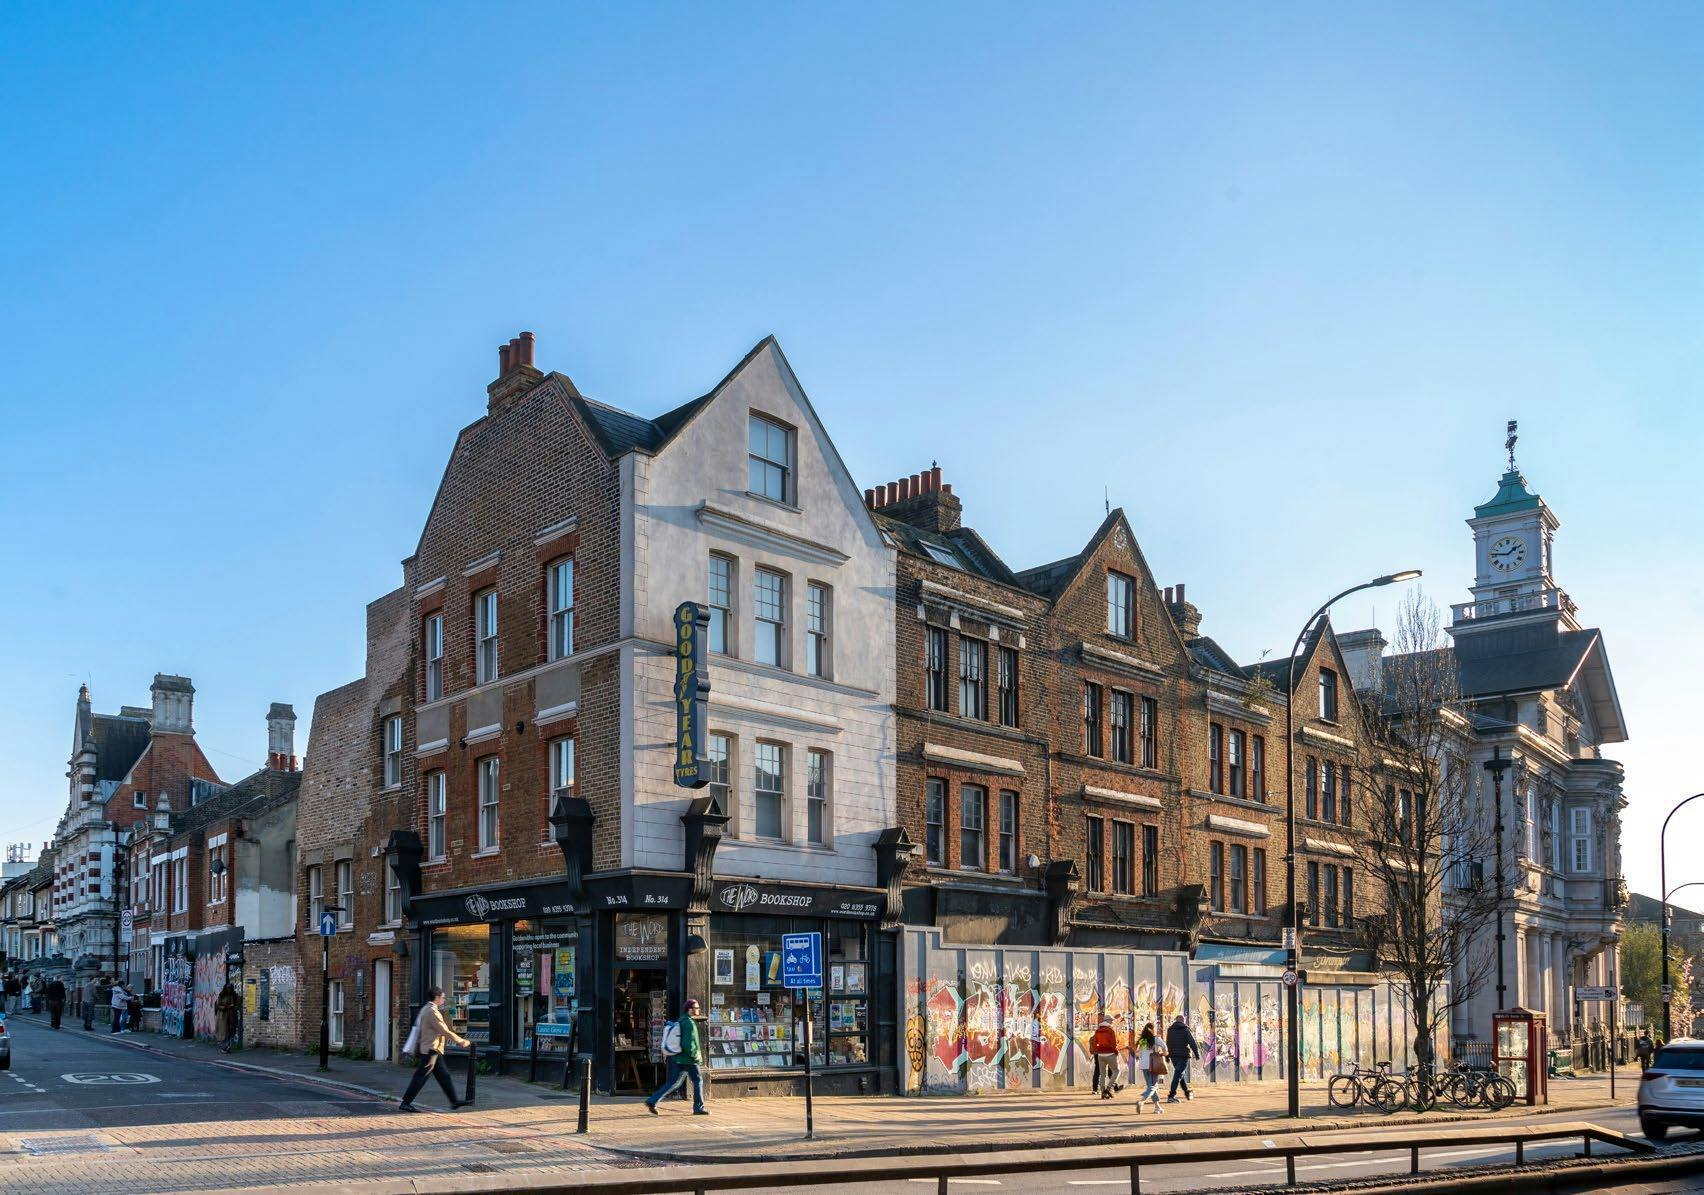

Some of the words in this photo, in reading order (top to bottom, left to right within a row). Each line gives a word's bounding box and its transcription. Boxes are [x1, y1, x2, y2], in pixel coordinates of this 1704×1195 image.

[676, 766, 698, 777] TYRES
[489, 898, 526, 911] BOOKSHOP
[657, 896, 669, 904] 314
[760, 893, 812, 907] BOOKSHOP
[624, 922, 638, 936] THE
[1284, 974, 1296, 982] 20
